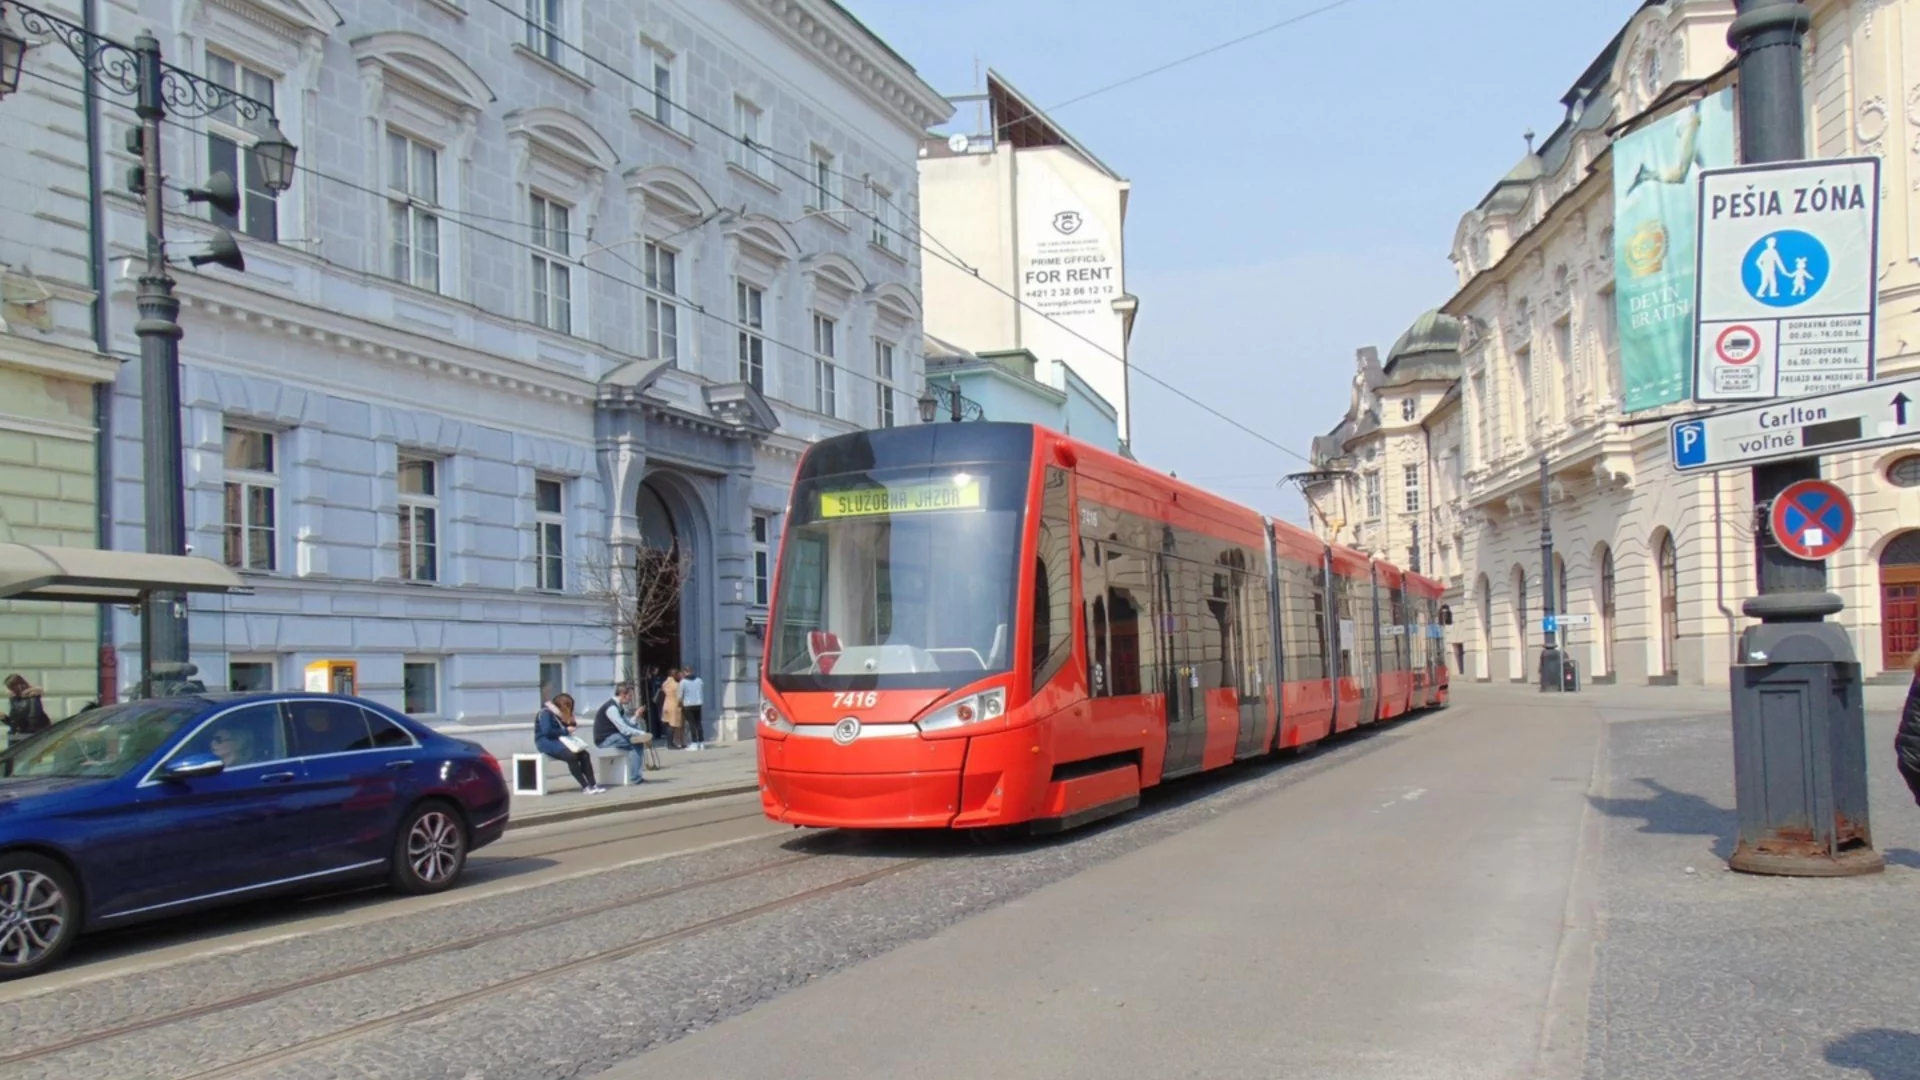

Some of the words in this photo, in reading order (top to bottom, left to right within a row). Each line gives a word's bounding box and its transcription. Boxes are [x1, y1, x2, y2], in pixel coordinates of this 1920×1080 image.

[1711, 185, 1782, 220] PEŠIA
[1793, 179, 1865, 214] ZÓNA
[1031, 257, 1061, 266] PRIME
[1063, 254, 1106, 265] OFFICES
[1025, 270, 1061, 285] FOR
[1066, 266, 1113, 282] RENT
[1759, 405, 1828, 429] Carlton
[1739, 430, 1796, 454] voľné
[832, 692, 878, 708] 7416
